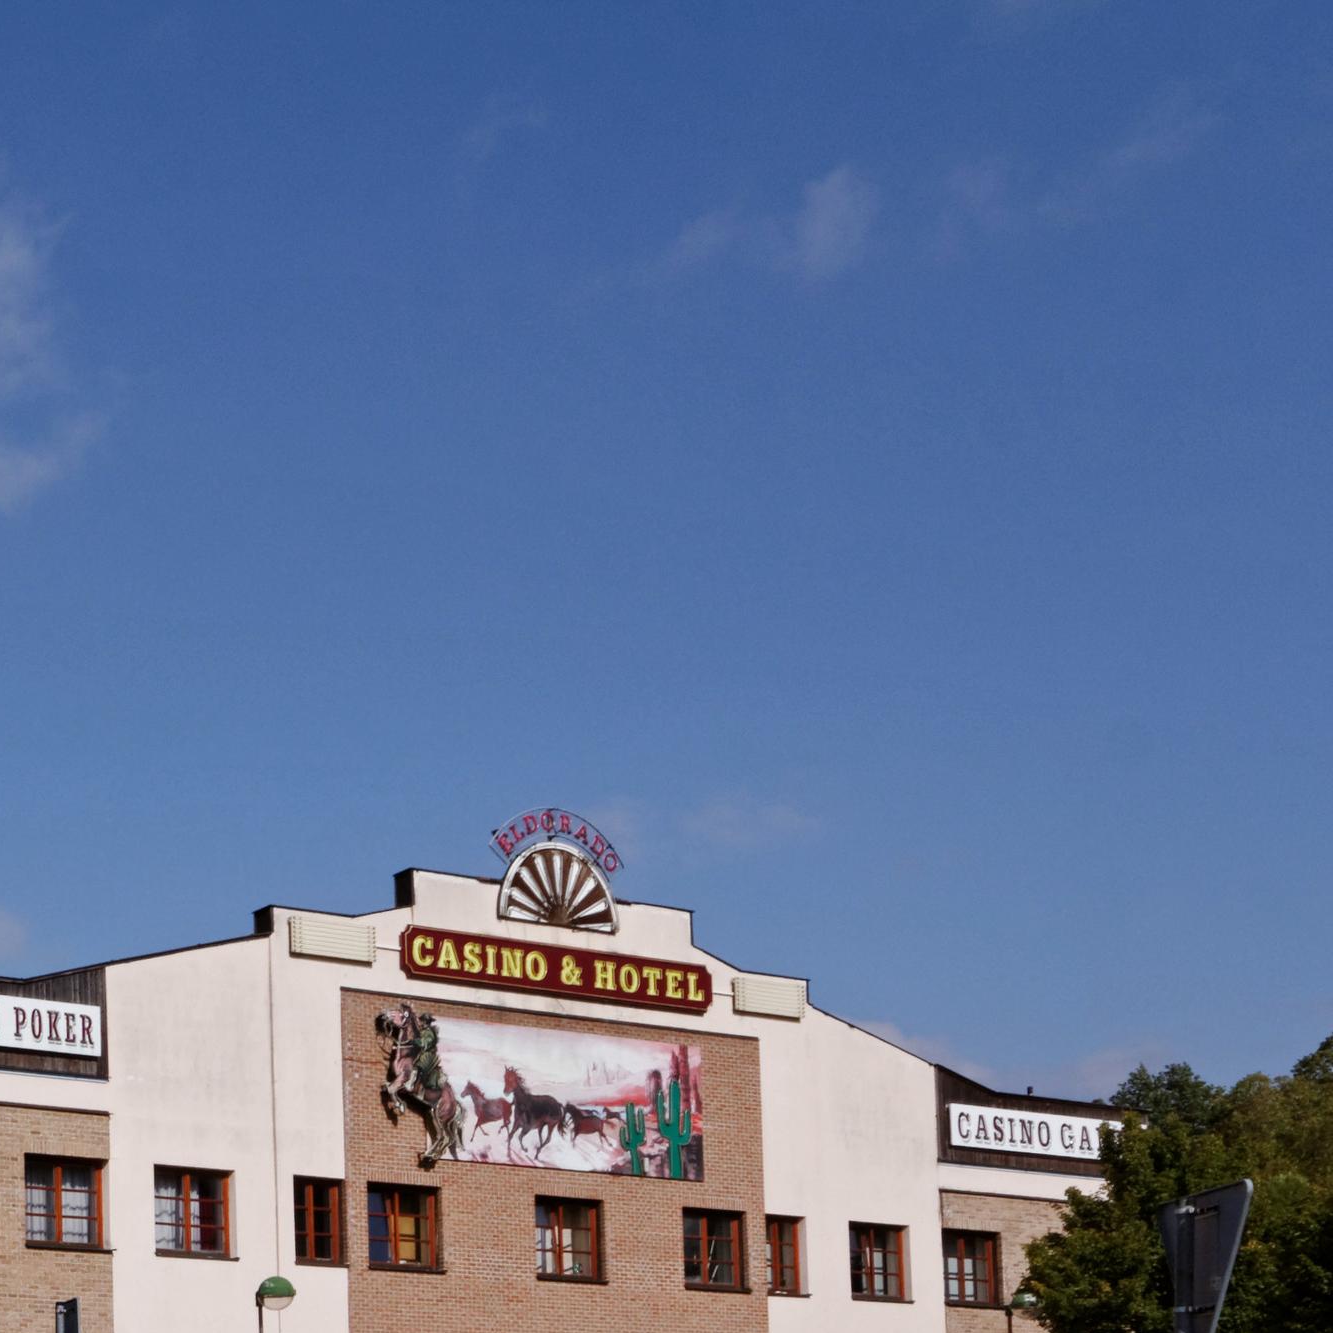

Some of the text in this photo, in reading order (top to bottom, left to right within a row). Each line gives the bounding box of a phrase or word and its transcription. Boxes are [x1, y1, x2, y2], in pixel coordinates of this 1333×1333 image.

[496, 810, 620, 874] ELDORADO
[411, 935, 705, 1002] CASINO & HOTEL
[13, 1006, 95, 1045] POKER
[957, 1112, 1103, 1151] CASINO GA
